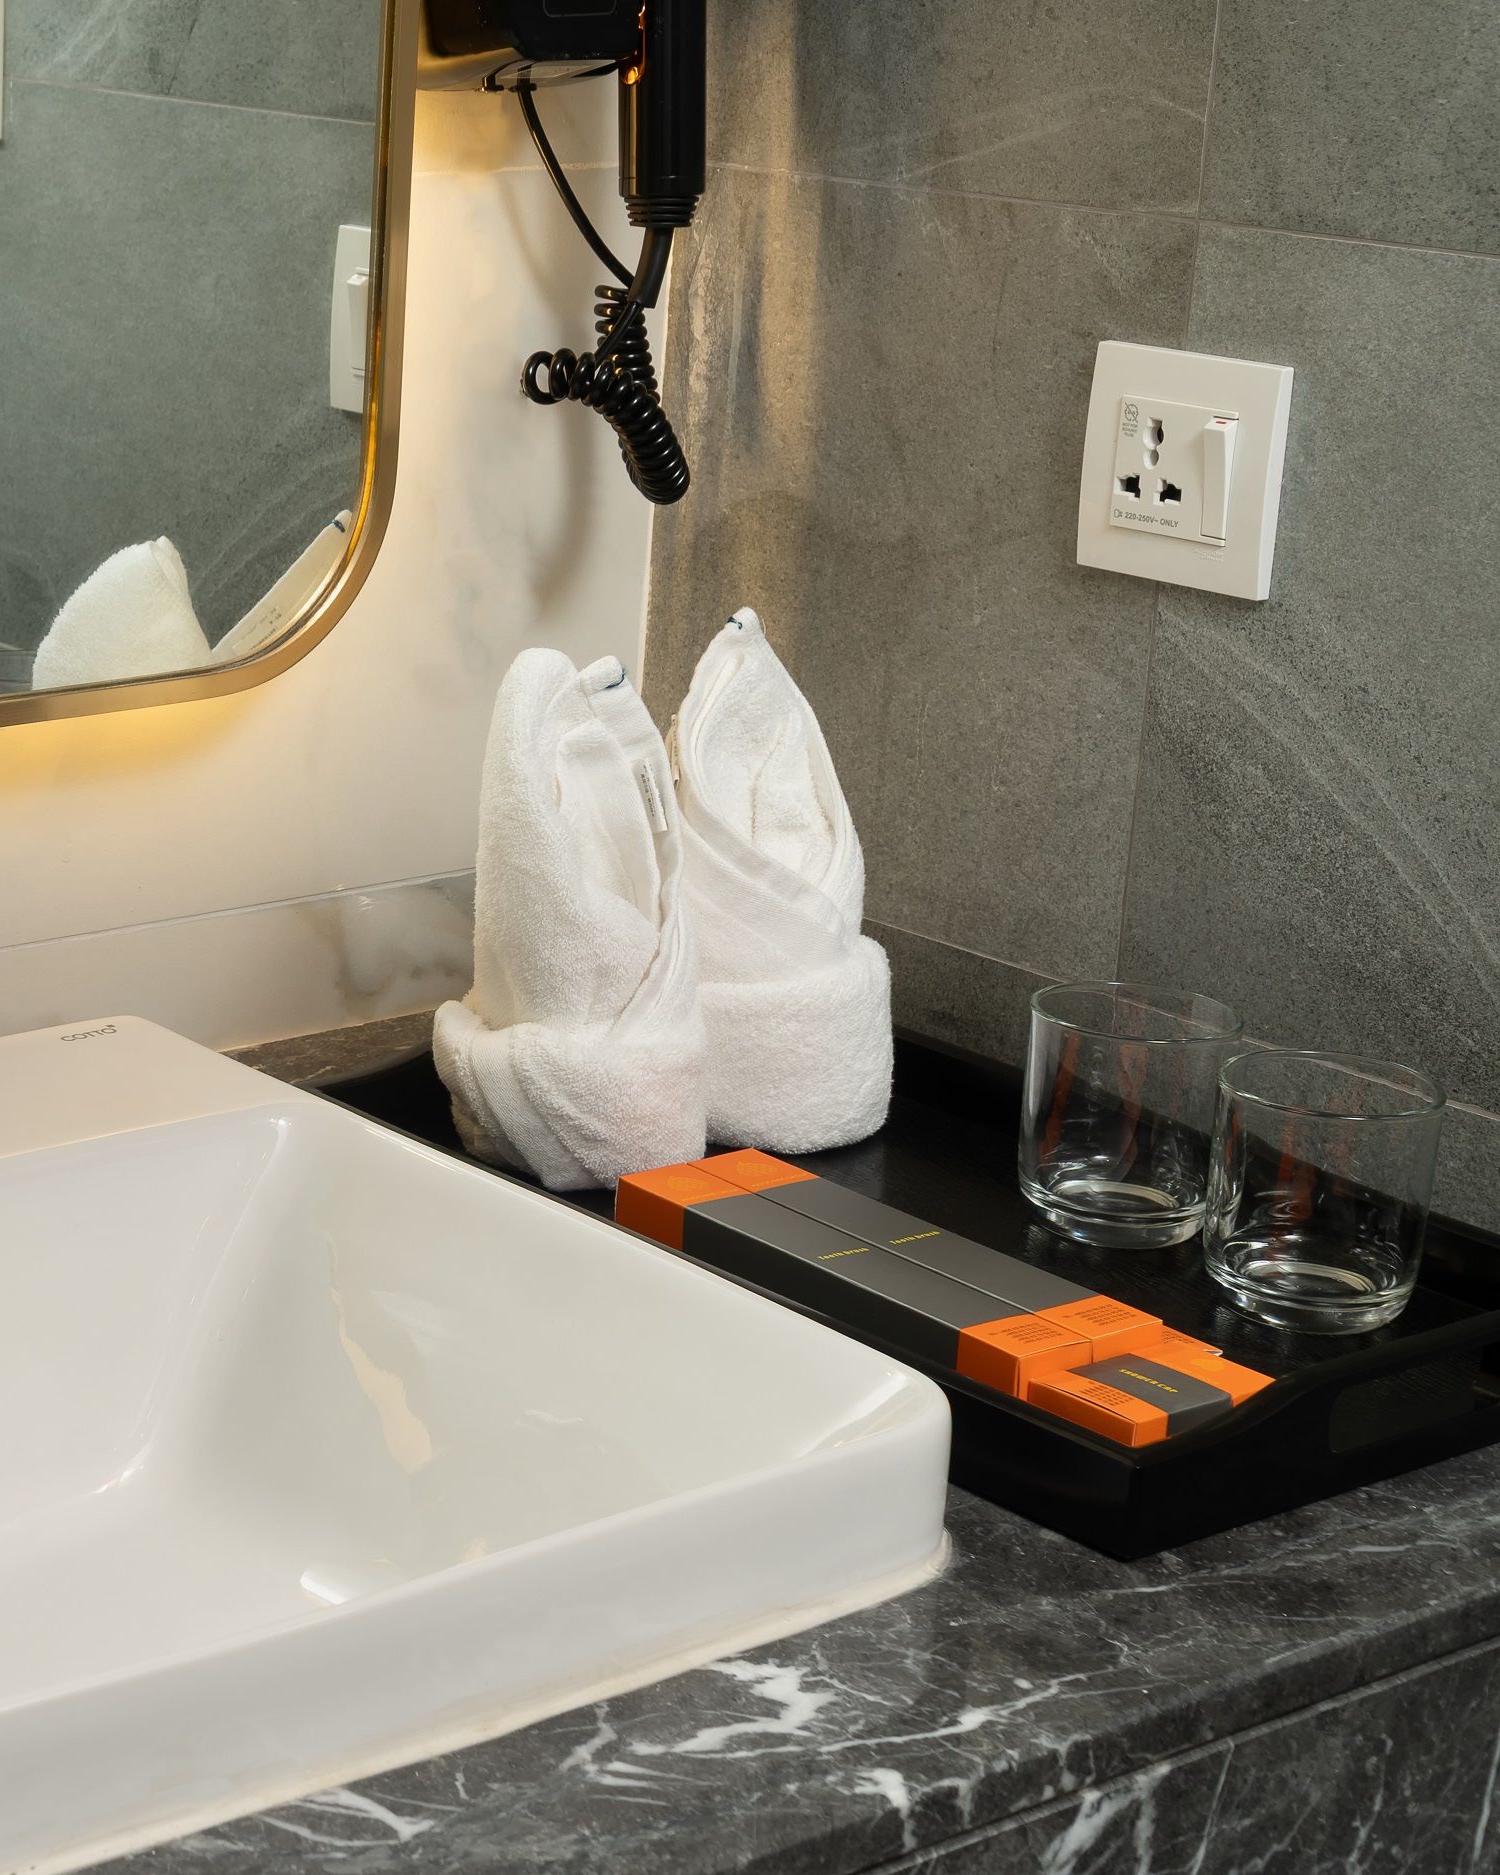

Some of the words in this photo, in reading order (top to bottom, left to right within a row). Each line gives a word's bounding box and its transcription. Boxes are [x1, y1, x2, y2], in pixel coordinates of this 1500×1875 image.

[1160, 518, 1179, 528] ONLY
[60, 1027, 117, 1042] COTTO
[889, 1237, 915, 1245] Tooth
[915, 1230, 940, 1239] brush
[818, 1252, 843, 1261] Tooth
[843, 1247, 869, 1255] brush
[1118, 1368, 1157, 1385] SHOWER
[1157, 1382, 1178, 1393] CAP
